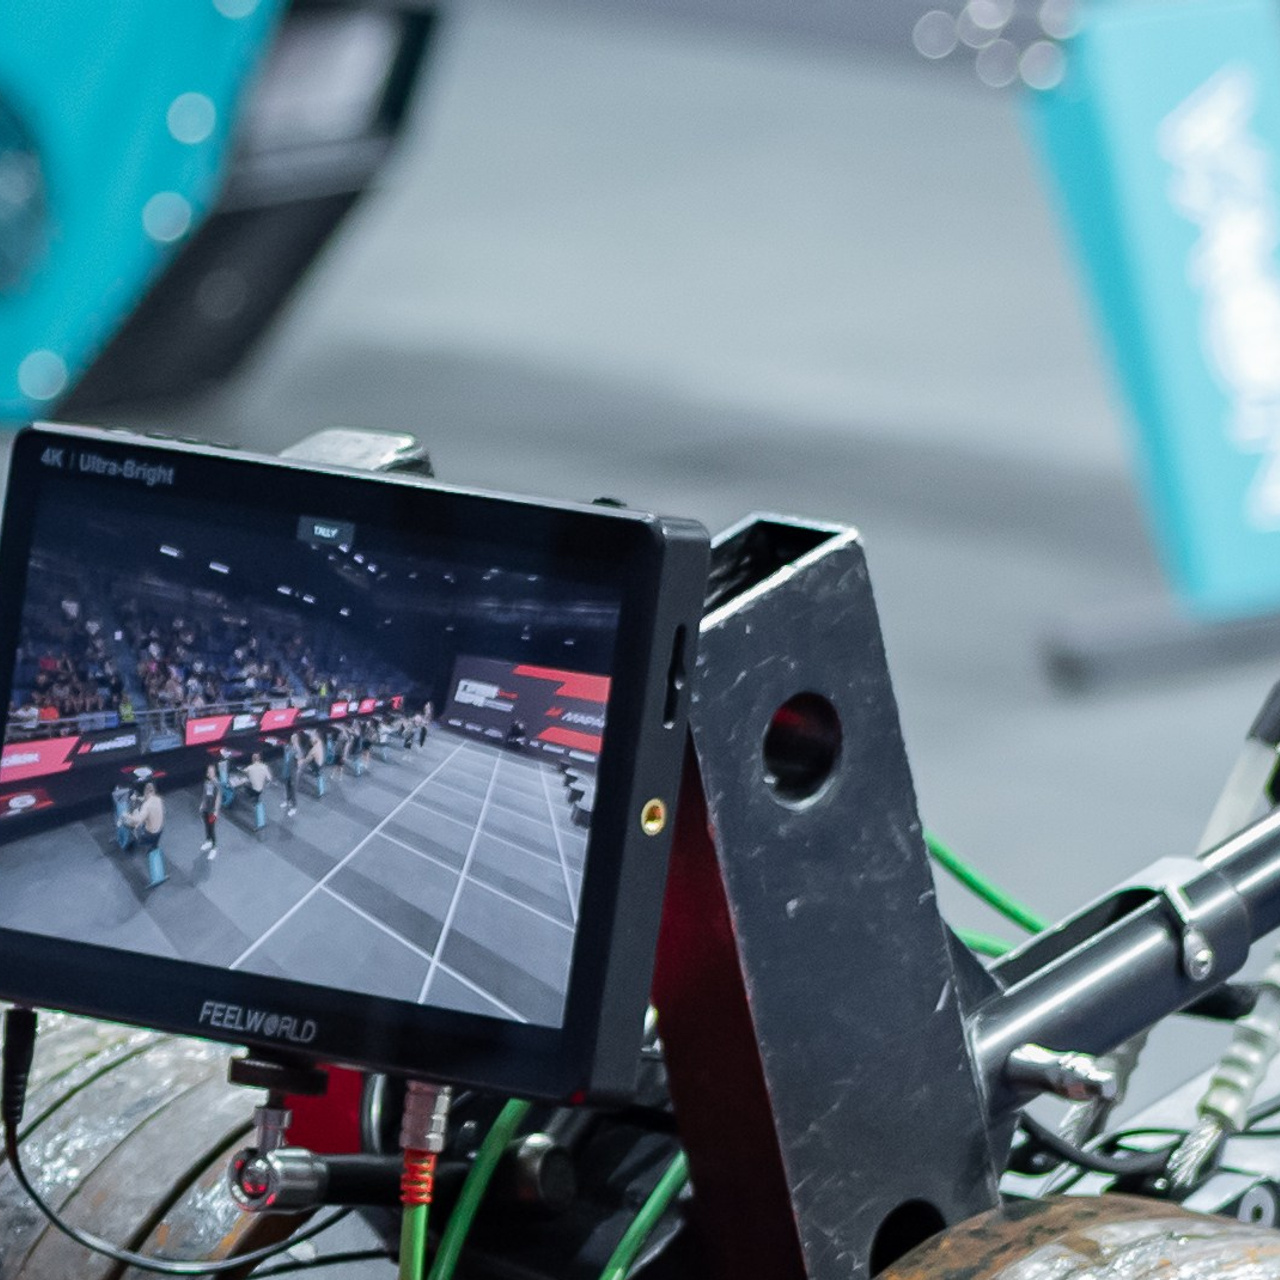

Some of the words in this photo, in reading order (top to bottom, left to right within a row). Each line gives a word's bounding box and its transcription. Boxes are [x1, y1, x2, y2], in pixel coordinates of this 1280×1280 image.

[40, 447, 64, 468] 4K
[78, 453, 176, 487] Ultra-Bright
[198, 1000, 317, 1043] FEELWORLD
